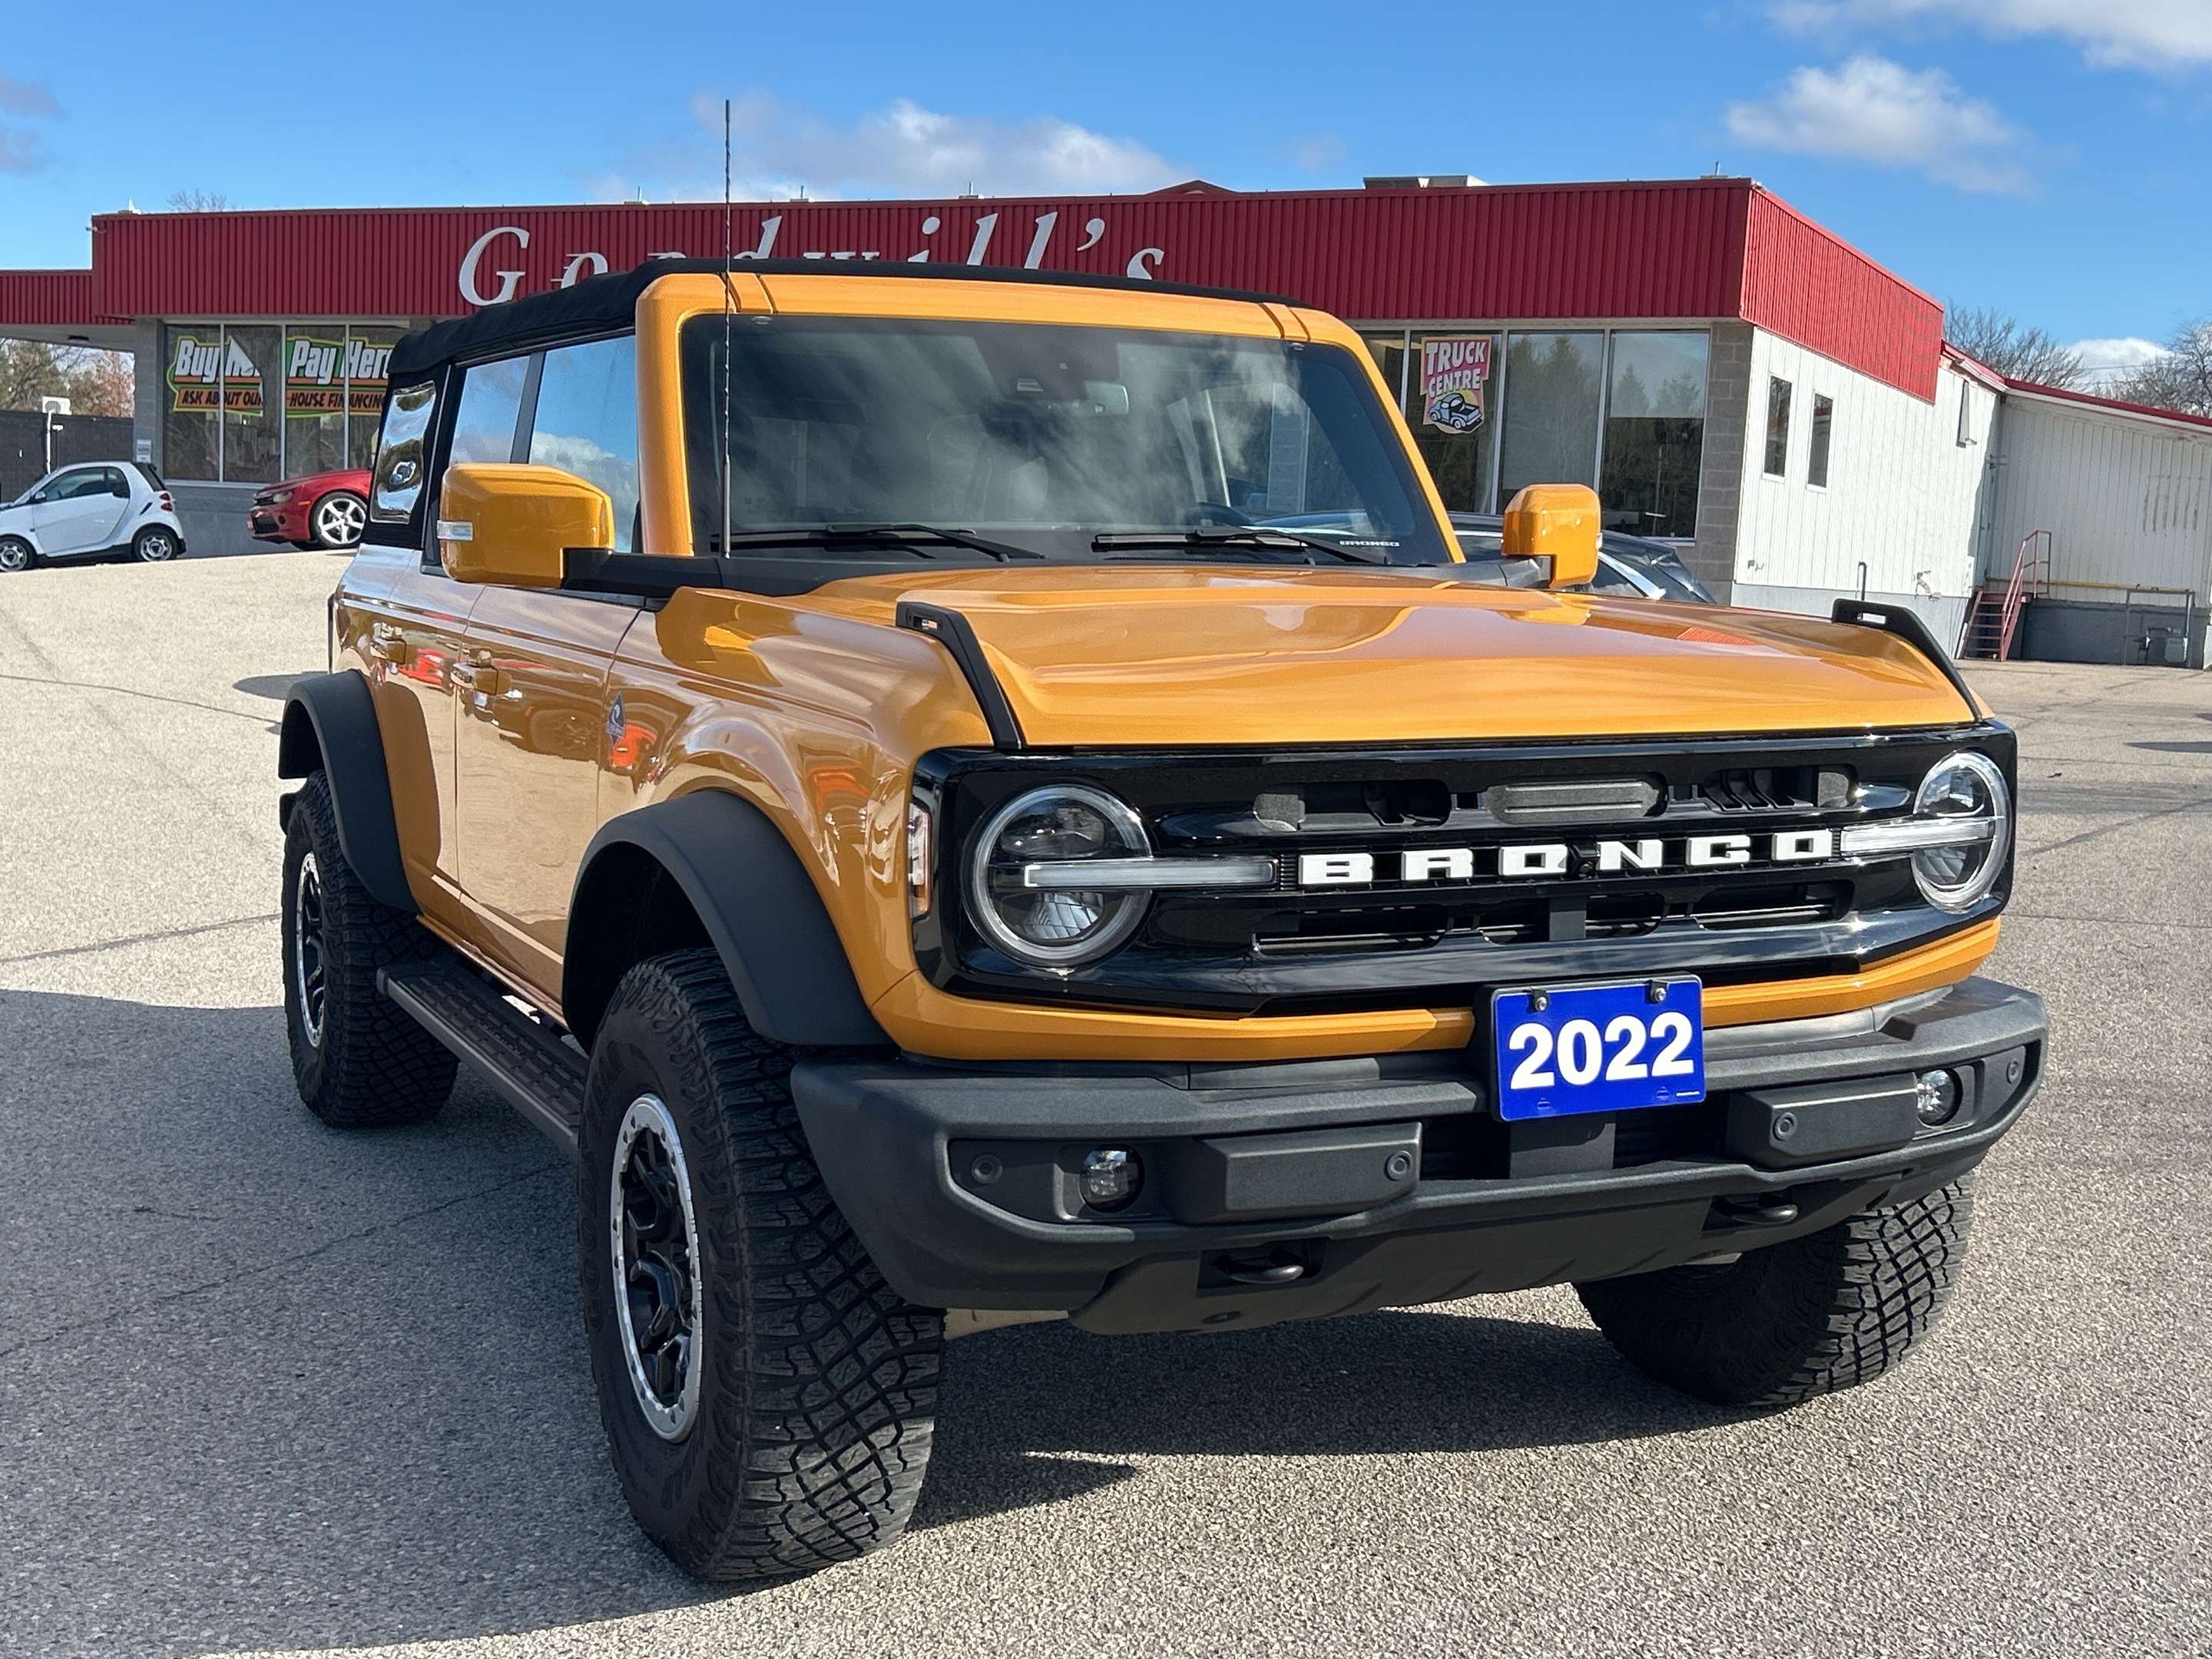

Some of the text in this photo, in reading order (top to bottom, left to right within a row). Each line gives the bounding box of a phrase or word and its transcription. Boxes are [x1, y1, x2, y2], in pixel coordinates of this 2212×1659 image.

[175, 339, 220, 383] Buy
[289, 340, 337, 384] Pay
[1426, 341, 1487, 376] TRUCK
[181, 390, 204, 405] ASK
[1429, 368, 1482, 399] CENTRE
[1298, 828, 1833, 885] BRONCO
[1508, 1011, 1694, 1090] 2022
